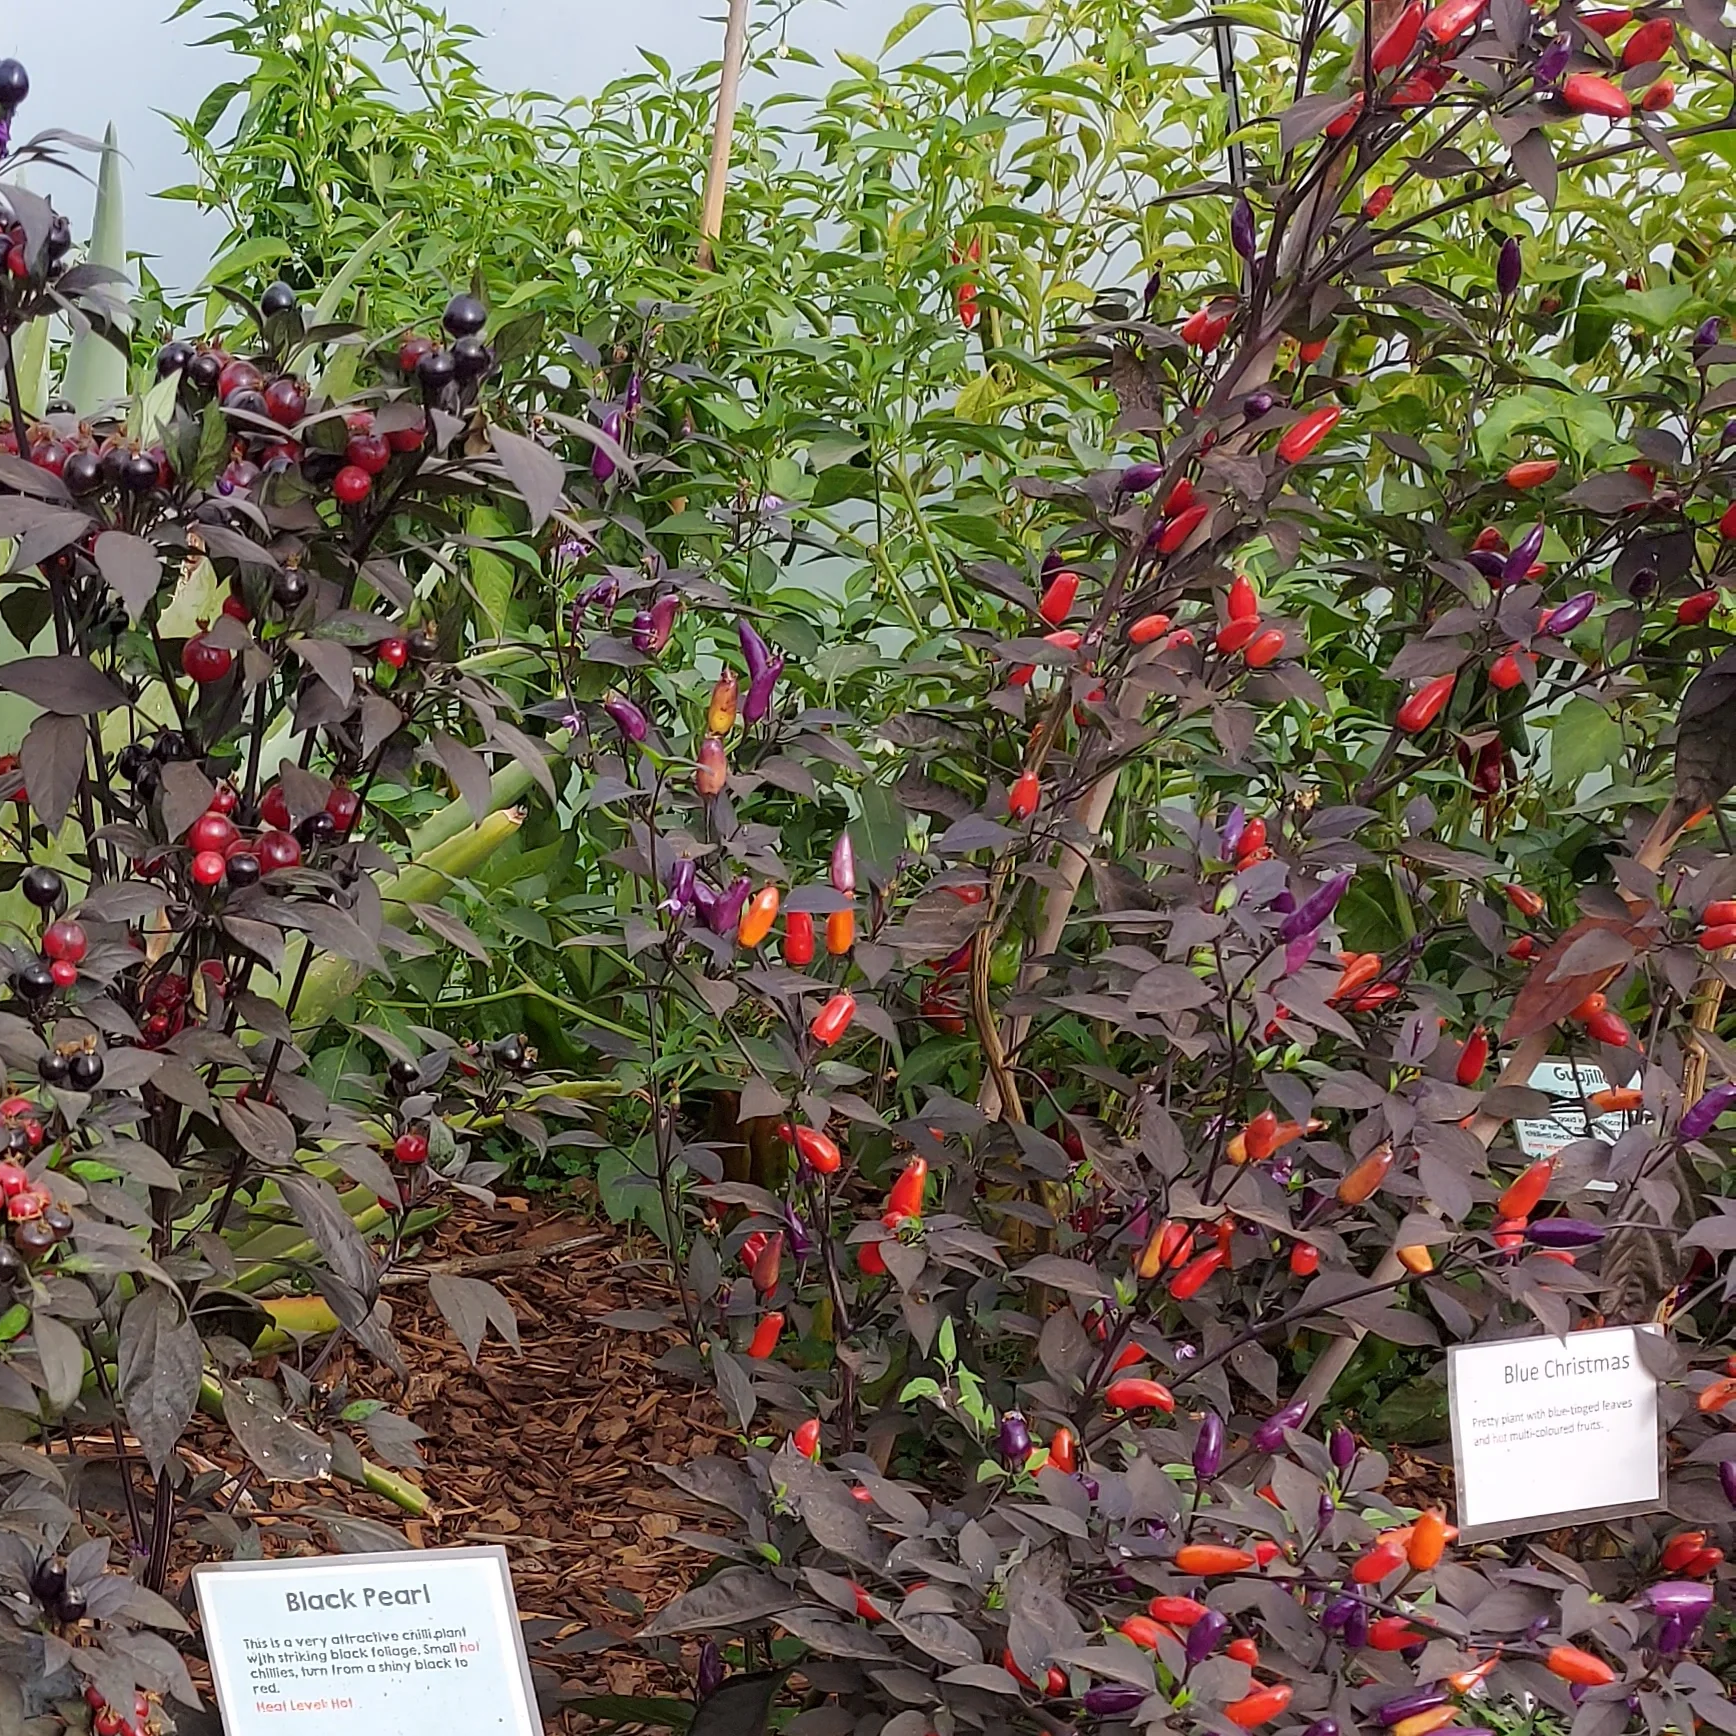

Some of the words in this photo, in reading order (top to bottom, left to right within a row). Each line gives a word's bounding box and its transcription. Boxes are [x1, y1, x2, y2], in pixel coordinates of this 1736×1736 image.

[1504, 1362, 1539, 1384] Blue
[1544, 1354, 1630, 1379] Christmas
[1472, 1417, 1499, 1428] Pretty
[1501, 1412, 1525, 1427] plant
[1527, 1408, 1545, 1421] with
[1602, 1399, 1633, 1411] leaves
[1474, 1433, 1490, 1446] and
[1509, 1423, 1574, 1441] multi-coloured
[285, 1588, 358, 1612] Black
[363, 1583, 431, 1607] Pearl
[243, 1638, 268, 1650] This
[270, 1637, 280, 1648] is
[284, 1639, 292, 1647] a
[295, 1637, 327, 1648] very
[331, 1631, 399, 1645] attractive
[402, 1628, 432, 1640] chilli
[436, 1626, 467, 1641] plant
[247, 1652, 275, 1665] with
[278, 1650, 327, 1663] striking
[330, 1648, 368, 1660] black
[423, 1642, 457, 1654] Small
[459, 1640, 480, 1653] hot
[250, 1667, 298, 1679] chillies,
[301, 1666, 328, 1677] turn
[332, 1664, 363, 1675] from
[367, 1664, 375, 1672] a
[379, 1660, 411, 1673] shiny
[415, 1658, 452, 1670] black
[454, 1657, 468, 1668] to
[253, 1683, 280, 1695] red.
[256, 1700, 286, 1712] Heat
[290, 1698, 327, 1711] Level:
[331, 1697, 353, 1709] Hot
